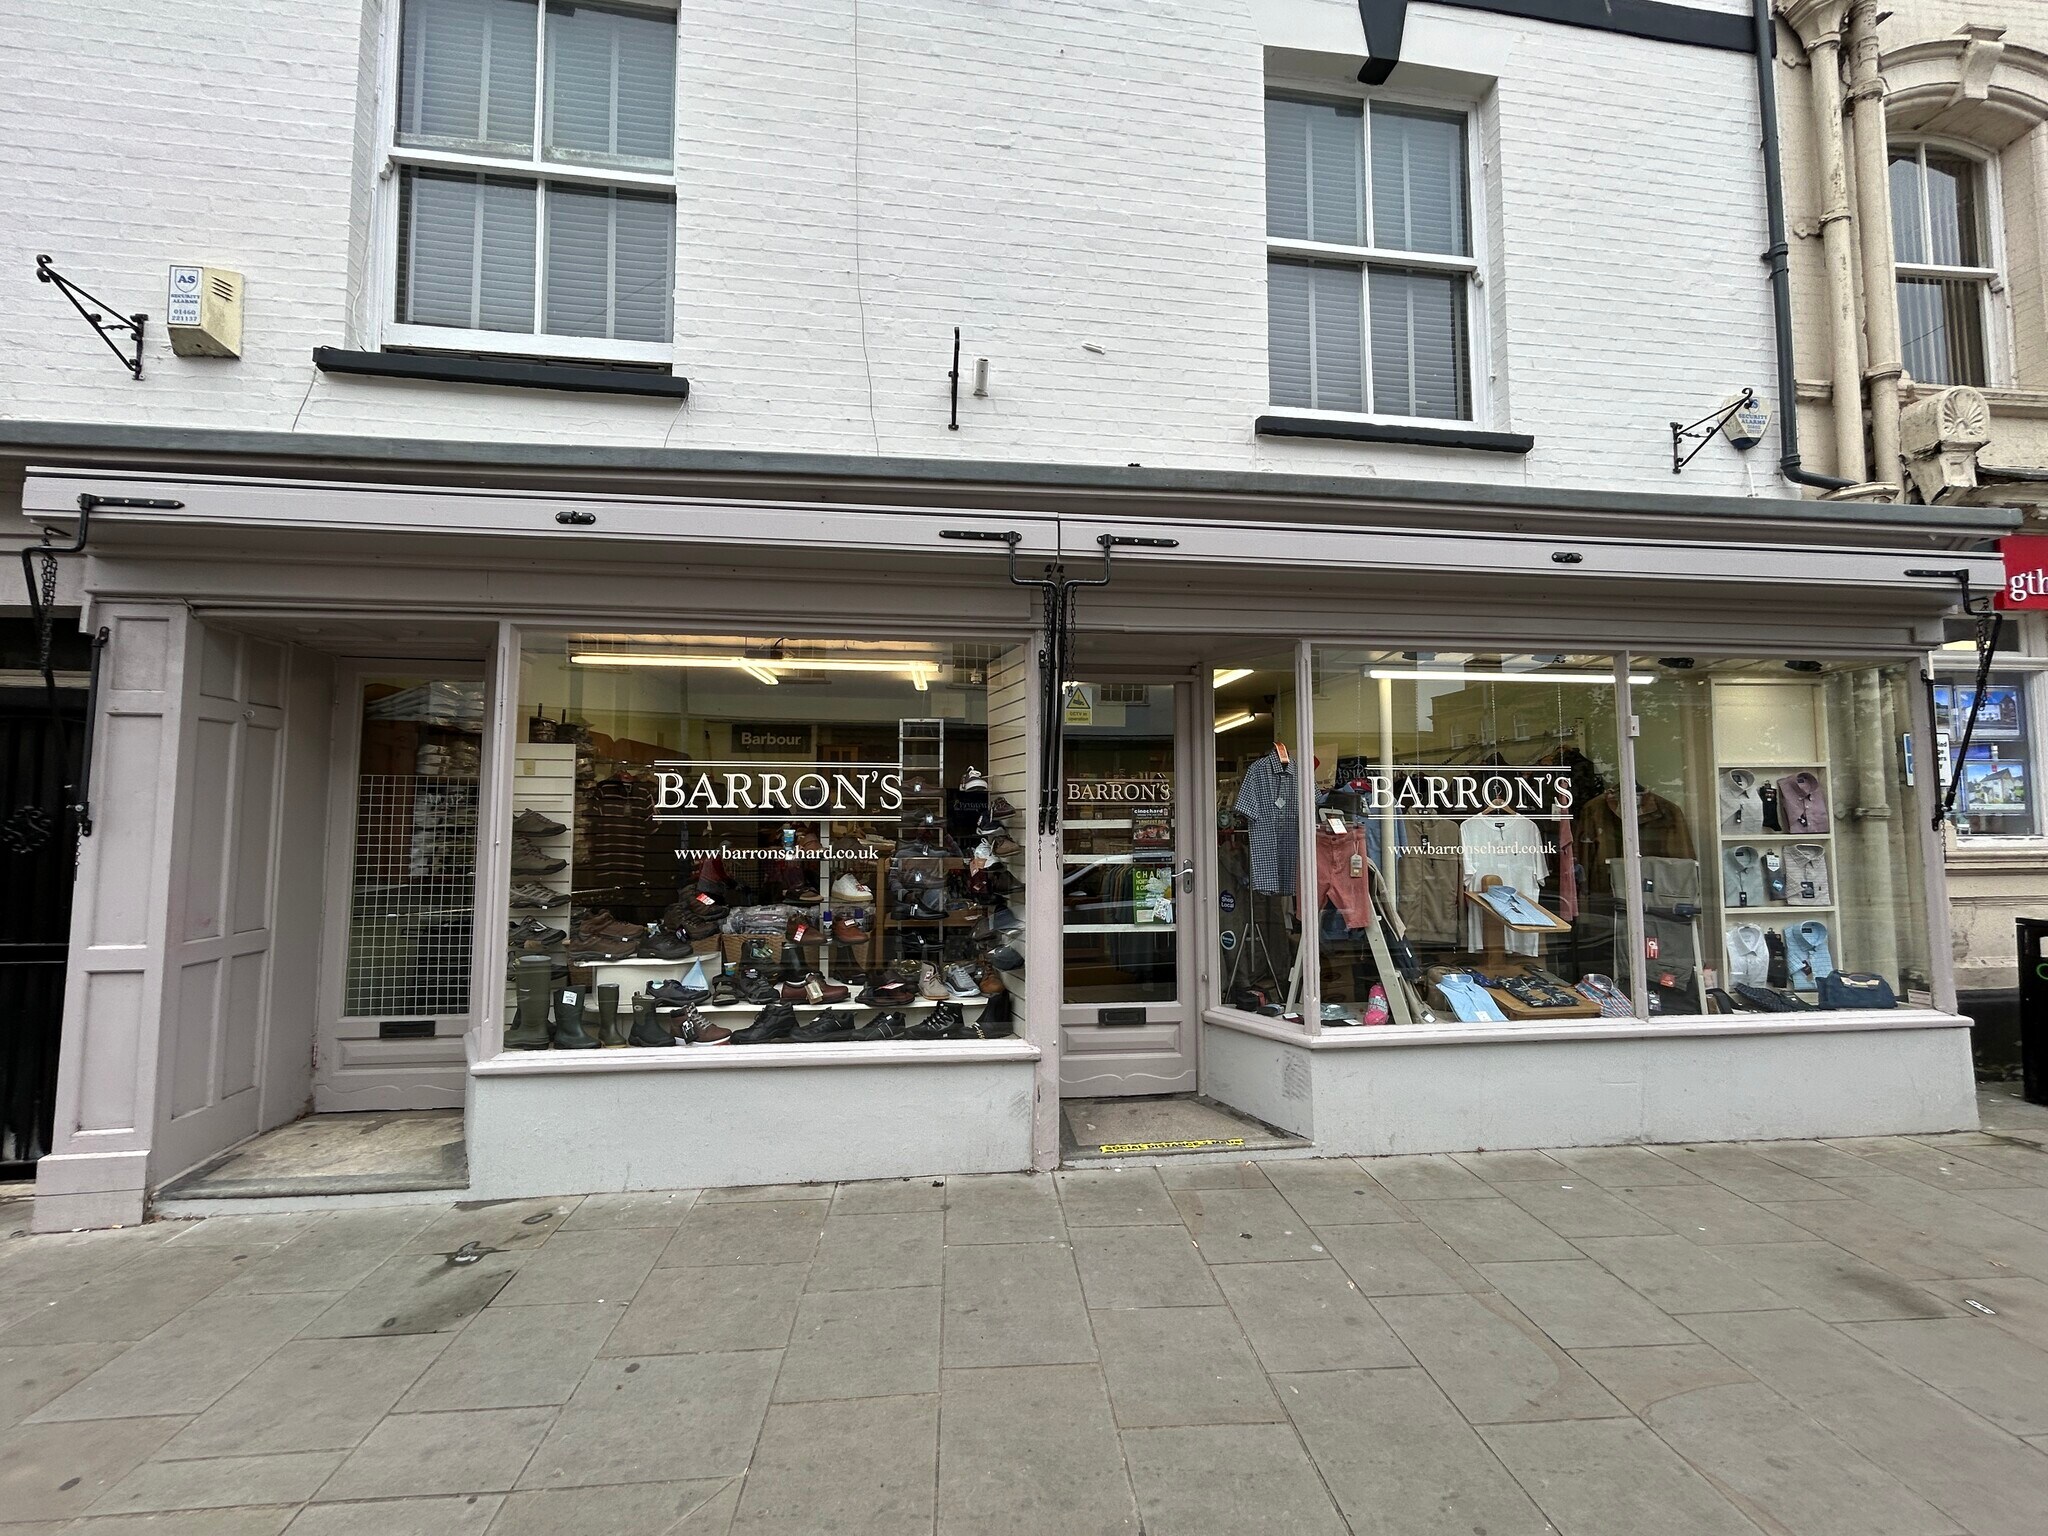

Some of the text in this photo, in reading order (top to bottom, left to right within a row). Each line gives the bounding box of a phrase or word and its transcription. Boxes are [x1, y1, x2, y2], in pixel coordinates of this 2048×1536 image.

[177, 275, 196, 284] AS
[741, 732, 802, 746] Barbour
[654, 770, 903, 810] BARRON'S
[1067, 783, 1171, 801] BARRON'S
[1367, 773, 1574, 810] BARRON'S
[1388, 841, 1557, 855] www.barronschard.co.uk
